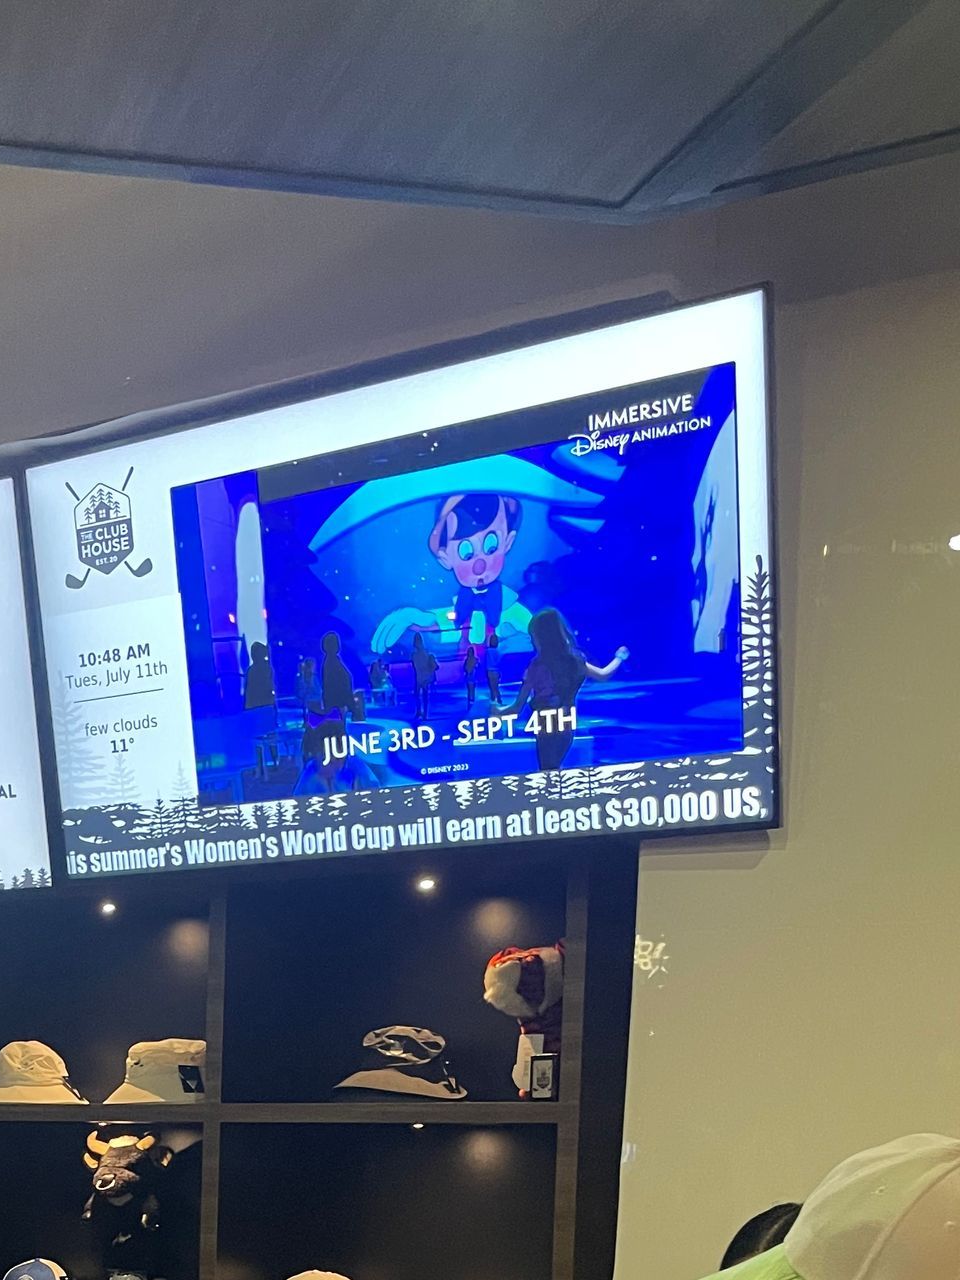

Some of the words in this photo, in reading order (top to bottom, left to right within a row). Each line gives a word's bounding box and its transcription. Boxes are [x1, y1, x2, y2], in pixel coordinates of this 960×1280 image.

[588, 394, 693, 431] IMMERSIVE
[631, 416, 711, 444] ANIMATION
[95, 523, 129, 540] CLUB
[81, 536, 130, 559] HOUSE
[78, 648, 121, 669] 10:48
[126, 643, 151, 661] AM
[66, 673, 102, 691] Tues,
[106, 665, 131, 687] July
[136, 661, 168, 679] 11th
[84, 722, 109, 736] few
[112, 715, 158, 733] clouds
[322, 731, 383, 766] JUNE
[388, 725, 436, 753] 3RD
[457, 713, 518, 744] SEPT
[524, 705, 577, 735] 4TH
[427, 764, 452, 775] DISNEY
[90, 841, 183, 874] summer's
[184, 833, 278, 866] Women's
[280, 826, 347, 857] World
[351, 823, 395, 852] Cup
[398, 817, 441, 846] will
[446, 815, 501, 843] earn
[506, 809, 532, 837] at
[536, 803, 602, 835] least
[605, 790, 721, 831] $30,000
[723, 786, 767, 819] US,
